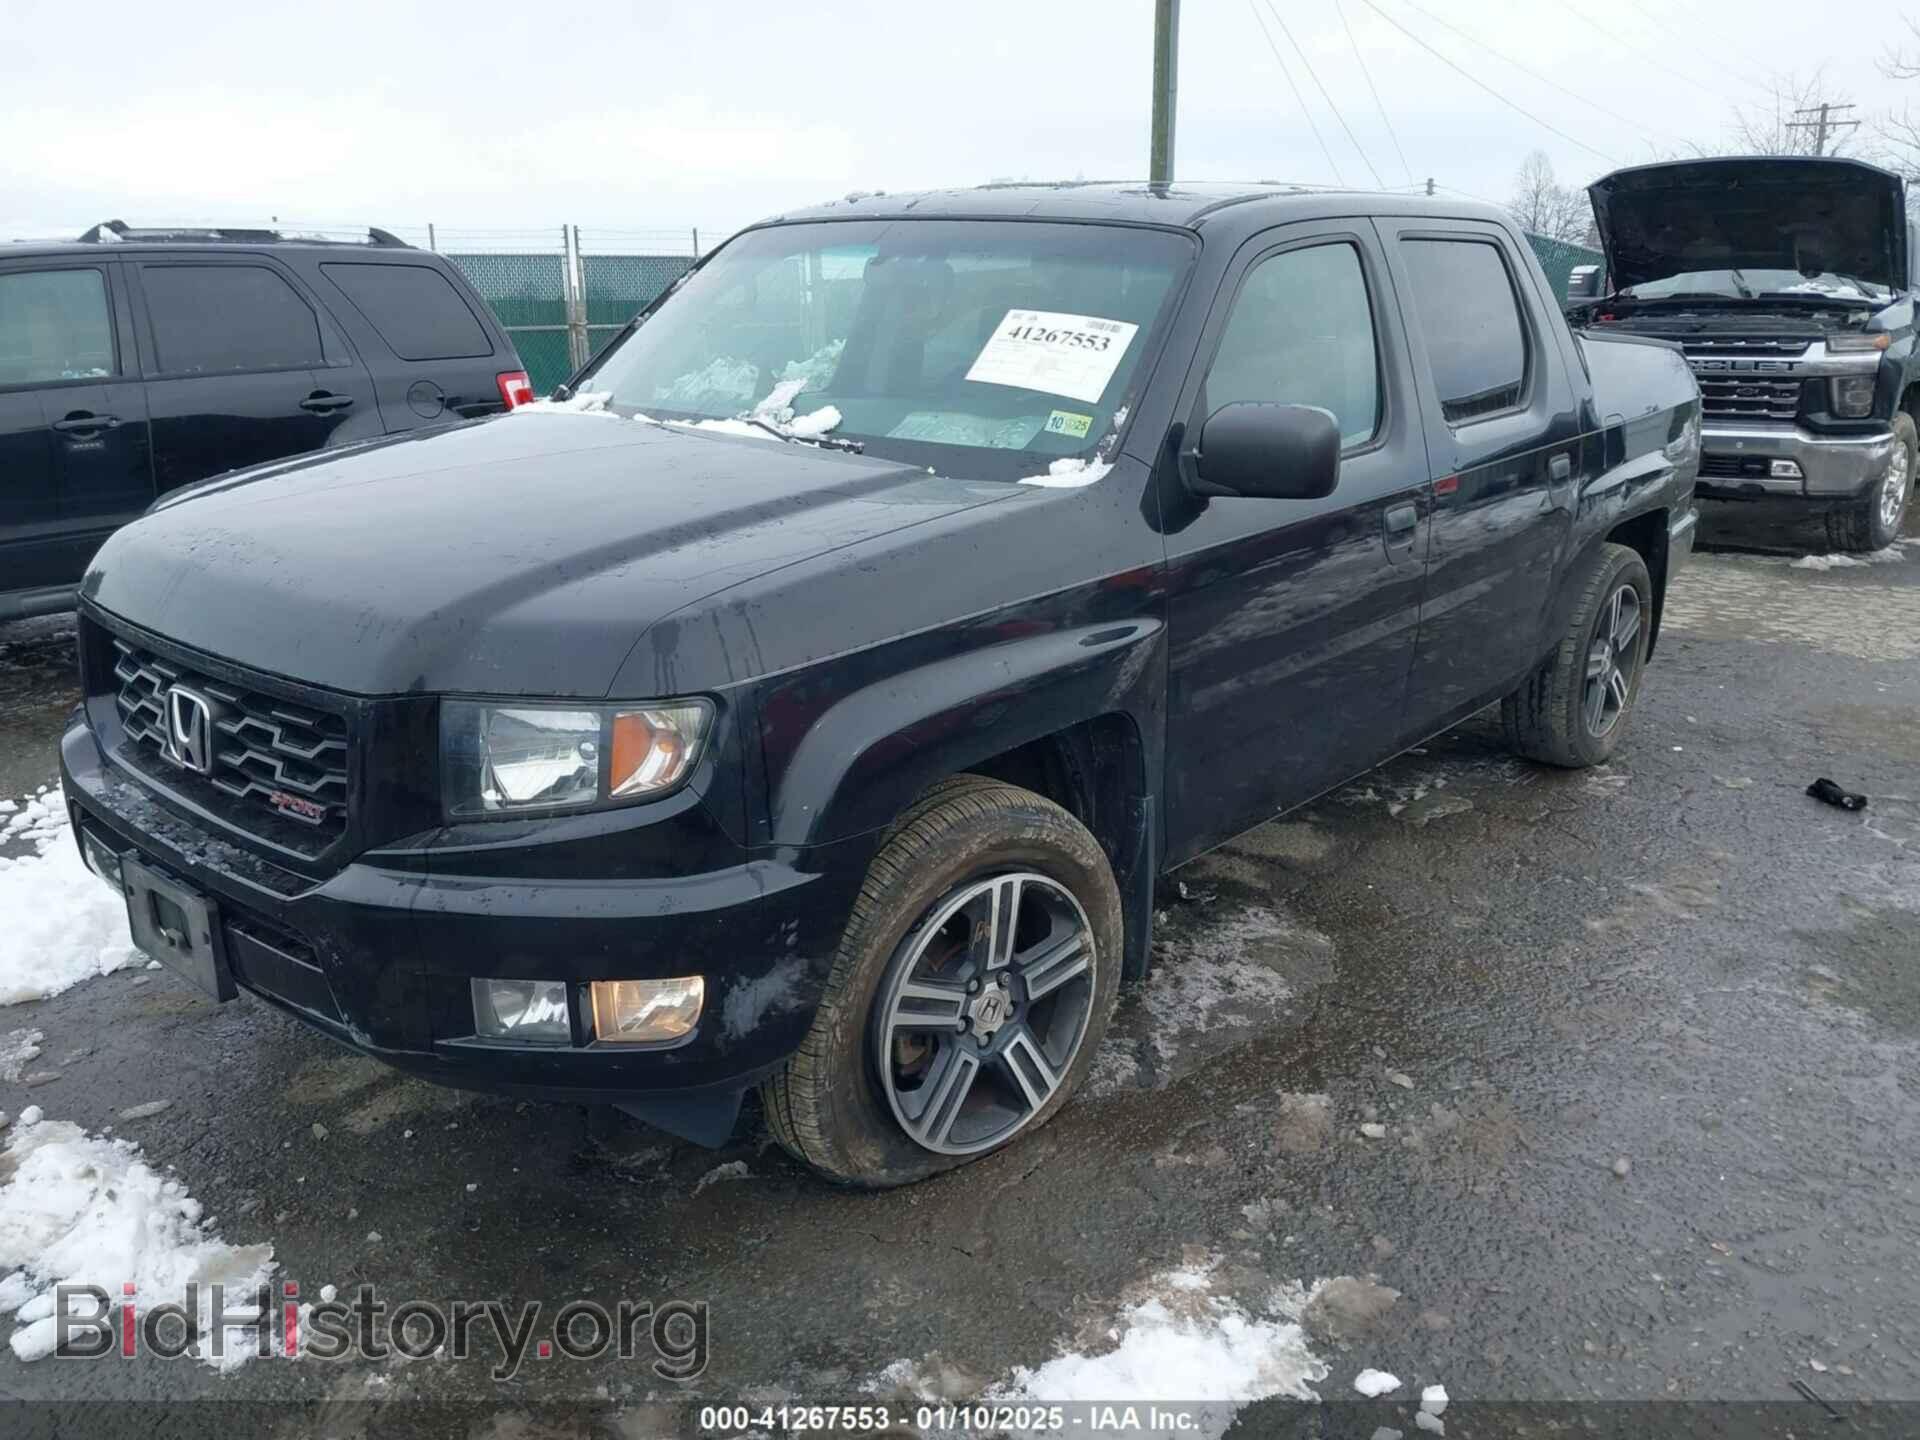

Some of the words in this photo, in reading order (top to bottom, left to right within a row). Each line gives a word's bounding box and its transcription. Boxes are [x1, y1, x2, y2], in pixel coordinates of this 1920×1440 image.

[1008, 325, 1112, 352] 41267553
[1051, 416, 1065, 429] 10
[1073, 419, 1087, 431] 25
